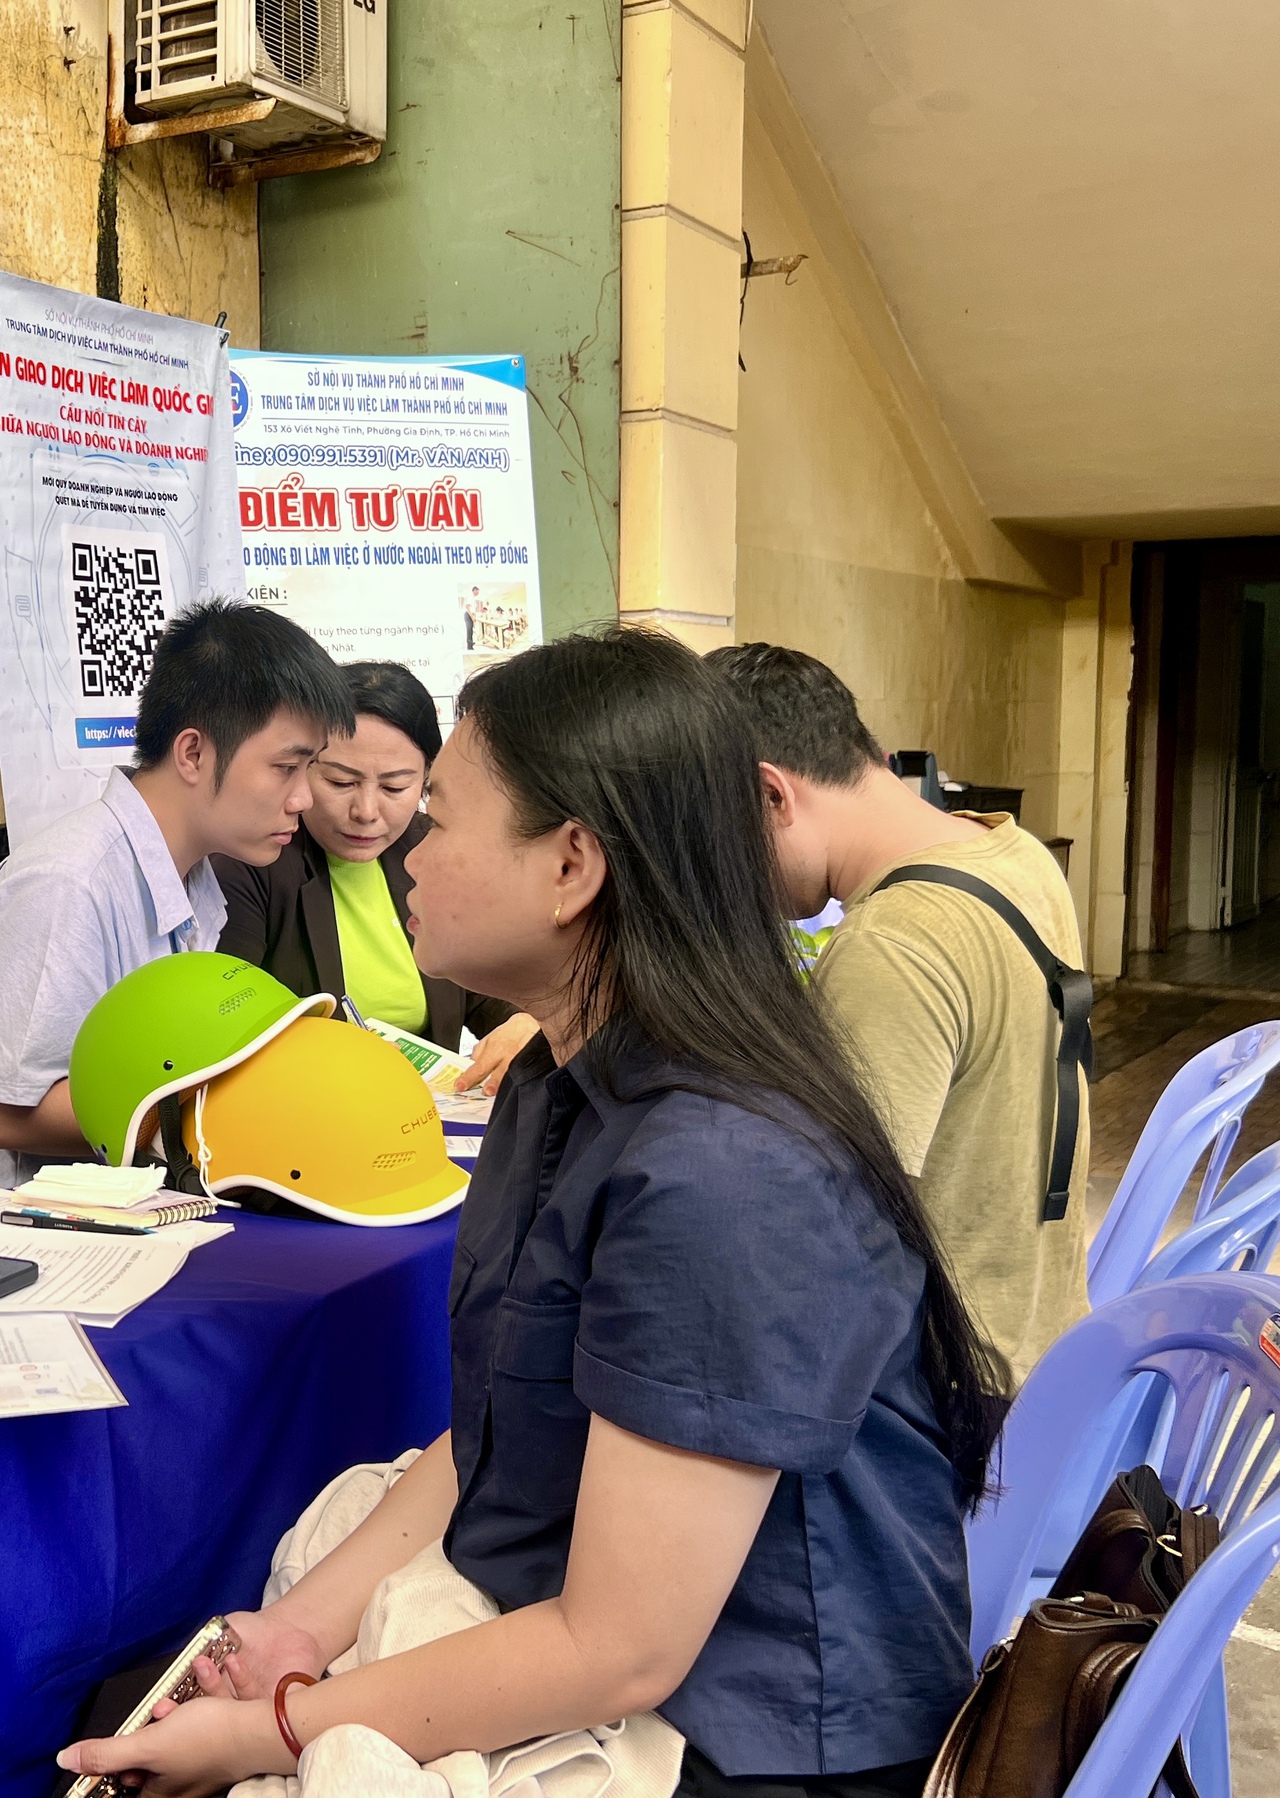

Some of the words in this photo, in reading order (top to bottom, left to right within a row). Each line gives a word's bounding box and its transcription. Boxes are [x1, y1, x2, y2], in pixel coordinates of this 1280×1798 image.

[6, 318, 31, 334] TRUNG
[32, 321, 48, 338] TÂM
[49, 328, 67, 344] DỊCH
[77, 334, 93, 350] VIỆC
[94, 338, 109, 352] LÀM
[109, 342, 133, 358] THÀNH
[134, 345, 148, 361] PHỐ
[159, 353, 170, 366] CHÍ
[171, 356, 189, 370] MINH
[15, 355, 47, 386] GIAO
[51, 364, 84, 397] DỊCH
[88, 371, 117, 405] VIỆC
[120, 376, 149, 407] LÀM
[152, 383, 193, 414] QUỐC
[307, 367, 320, 386] SỞ
[323, 369, 339, 390] NỘI
[341, 372, 353, 391] VỤ
[356, 371, 386, 389] THÀNH
[389, 370, 406, 389] PHỐ
[424, 374, 438, 391] CHÍ
[441, 376, 464, 392] MINH
[84, 405, 105, 428] NỐI
[107, 413, 126, 430] TIN
[261, 395, 292, 410] TRUNG
[295, 393, 315, 411] TÂM
[318, 396, 340, 414] DỊCH
[342, 397, 355, 415] VỤ
[357, 394, 378, 415] VIỆC
[380, 395, 400, 413] LÀM
[402, 397, 431, 414] THÀNH
[434, 394, 451, 415] PHỐ
[468, 399, 483, 415] CHÍ
[485, 401, 508, 416] MINH
[26, 420, 60, 441] NGƯỜI
[62, 429, 82, 446] LAO
[84, 431, 117, 452] ĐỘNG
[117, 436, 133, 454] VÀ
[135, 440, 172, 460] DOANH
[263, 424, 278, 433] 153
[294, 424, 313, 434] Viết
[315, 425, 340, 436] Nghệ
[367, 426, 401, 437] Phường
[403, 428, 418, 436] Gia
[444, 429, 458, 437] TP.
[474, 429, 487, 437] Chí
[489, 430, 510, 438] Minh
[275, 446, 386, 464] 090.991.5391
[389, 447, 422, 469] (Mr.
[429, 444, 464, 466] VÂN
[469, 449, 509, 471] ANH)
[68, 481, 90, 493] DOANH
[144, 491, 157, 501] LAO
[238, 474, 338, 528] ĐIỂM
[348, 487, 399, 528] TƯ
[405, 478, 481, 528] VẤN
[254, 545, 287, 571] ĐỘNG
[290, 547, 302, 566] ĐI
[305, 543, 331, 566] LÀM
[333, 542, 359, 570] VIỆC
[363, 540, 371, 566] Ở
[374, 543, 405, 565] NƯỚC
[408, 543, 442, 565] NGOÀI
[445, 546, 472, 565] THEO
[475, 546, 497, 569] HỢP
[500, 539, 529, 565] ĐỒNG
[336, 626, 358, 635] theo
[384, 625, 414, 636] ngành
